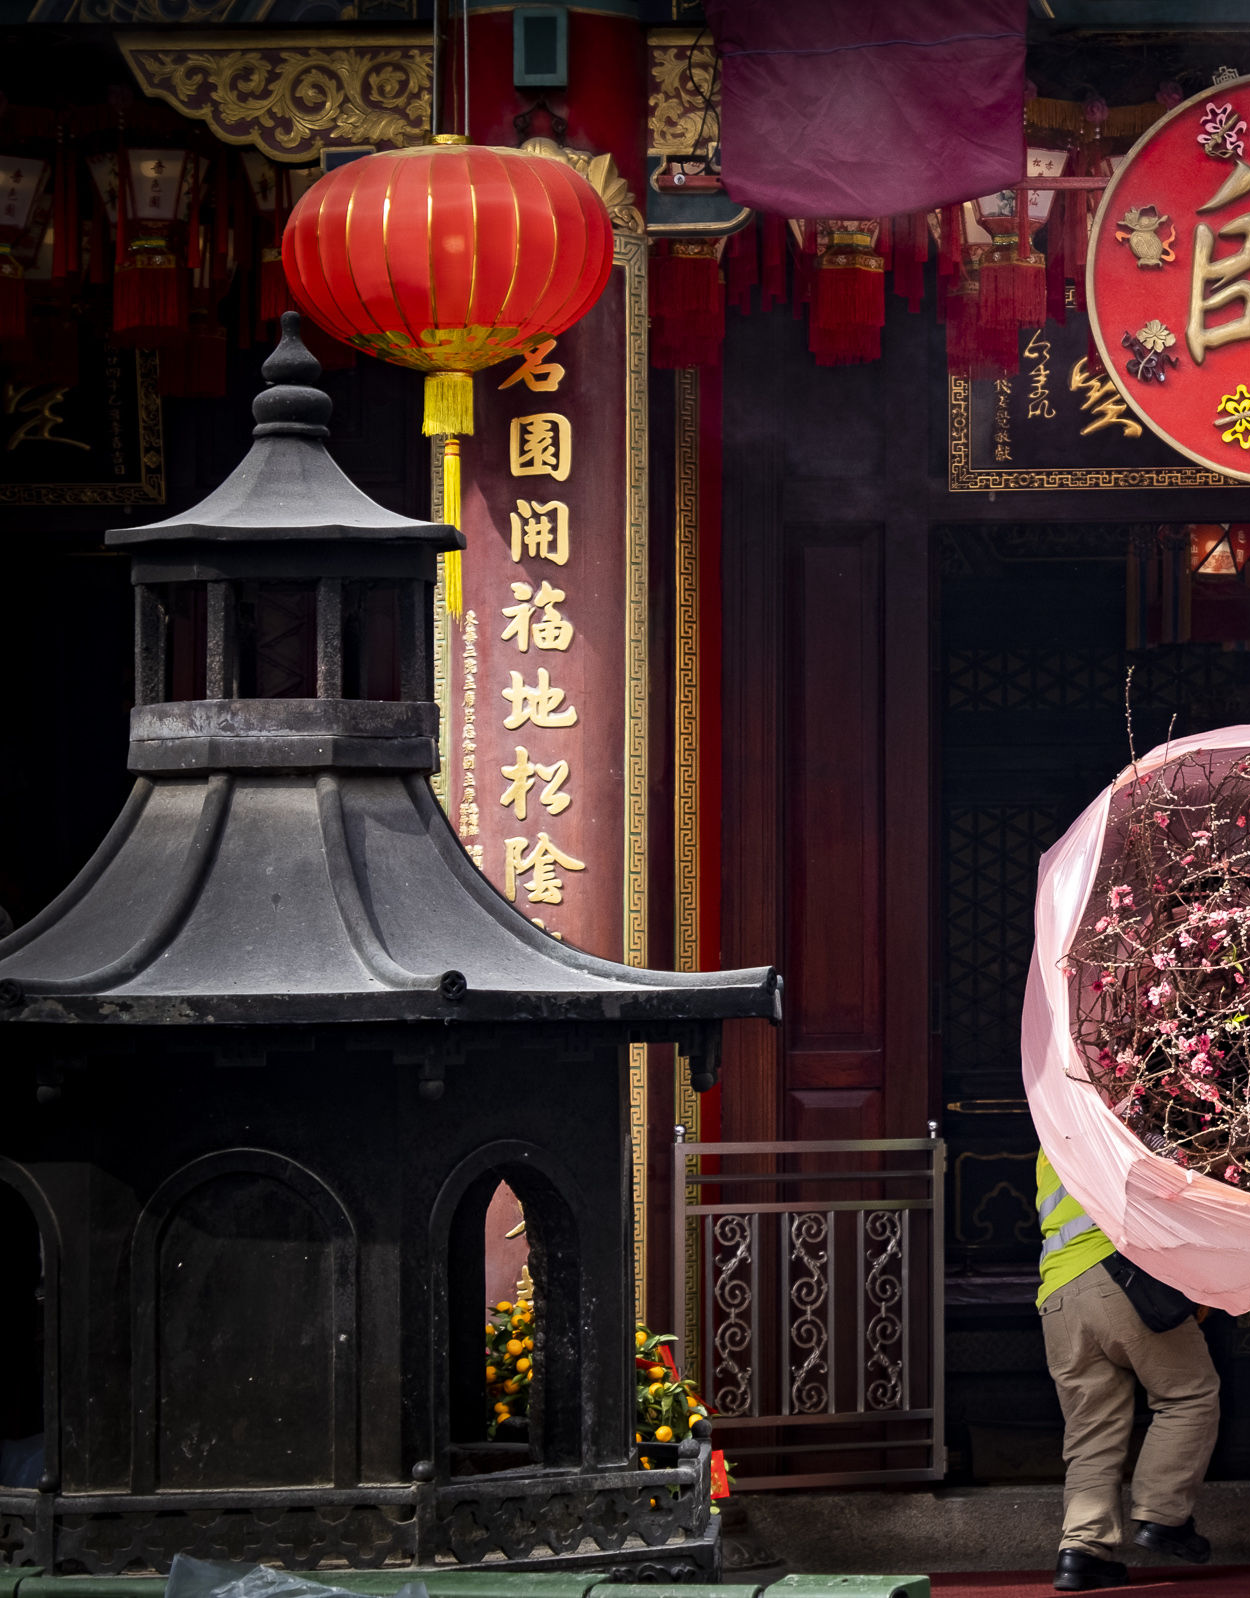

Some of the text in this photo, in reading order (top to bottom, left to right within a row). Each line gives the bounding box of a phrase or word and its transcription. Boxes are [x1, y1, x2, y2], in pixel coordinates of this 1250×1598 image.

[497, 338, 586, 940] 名園開福地松陰
